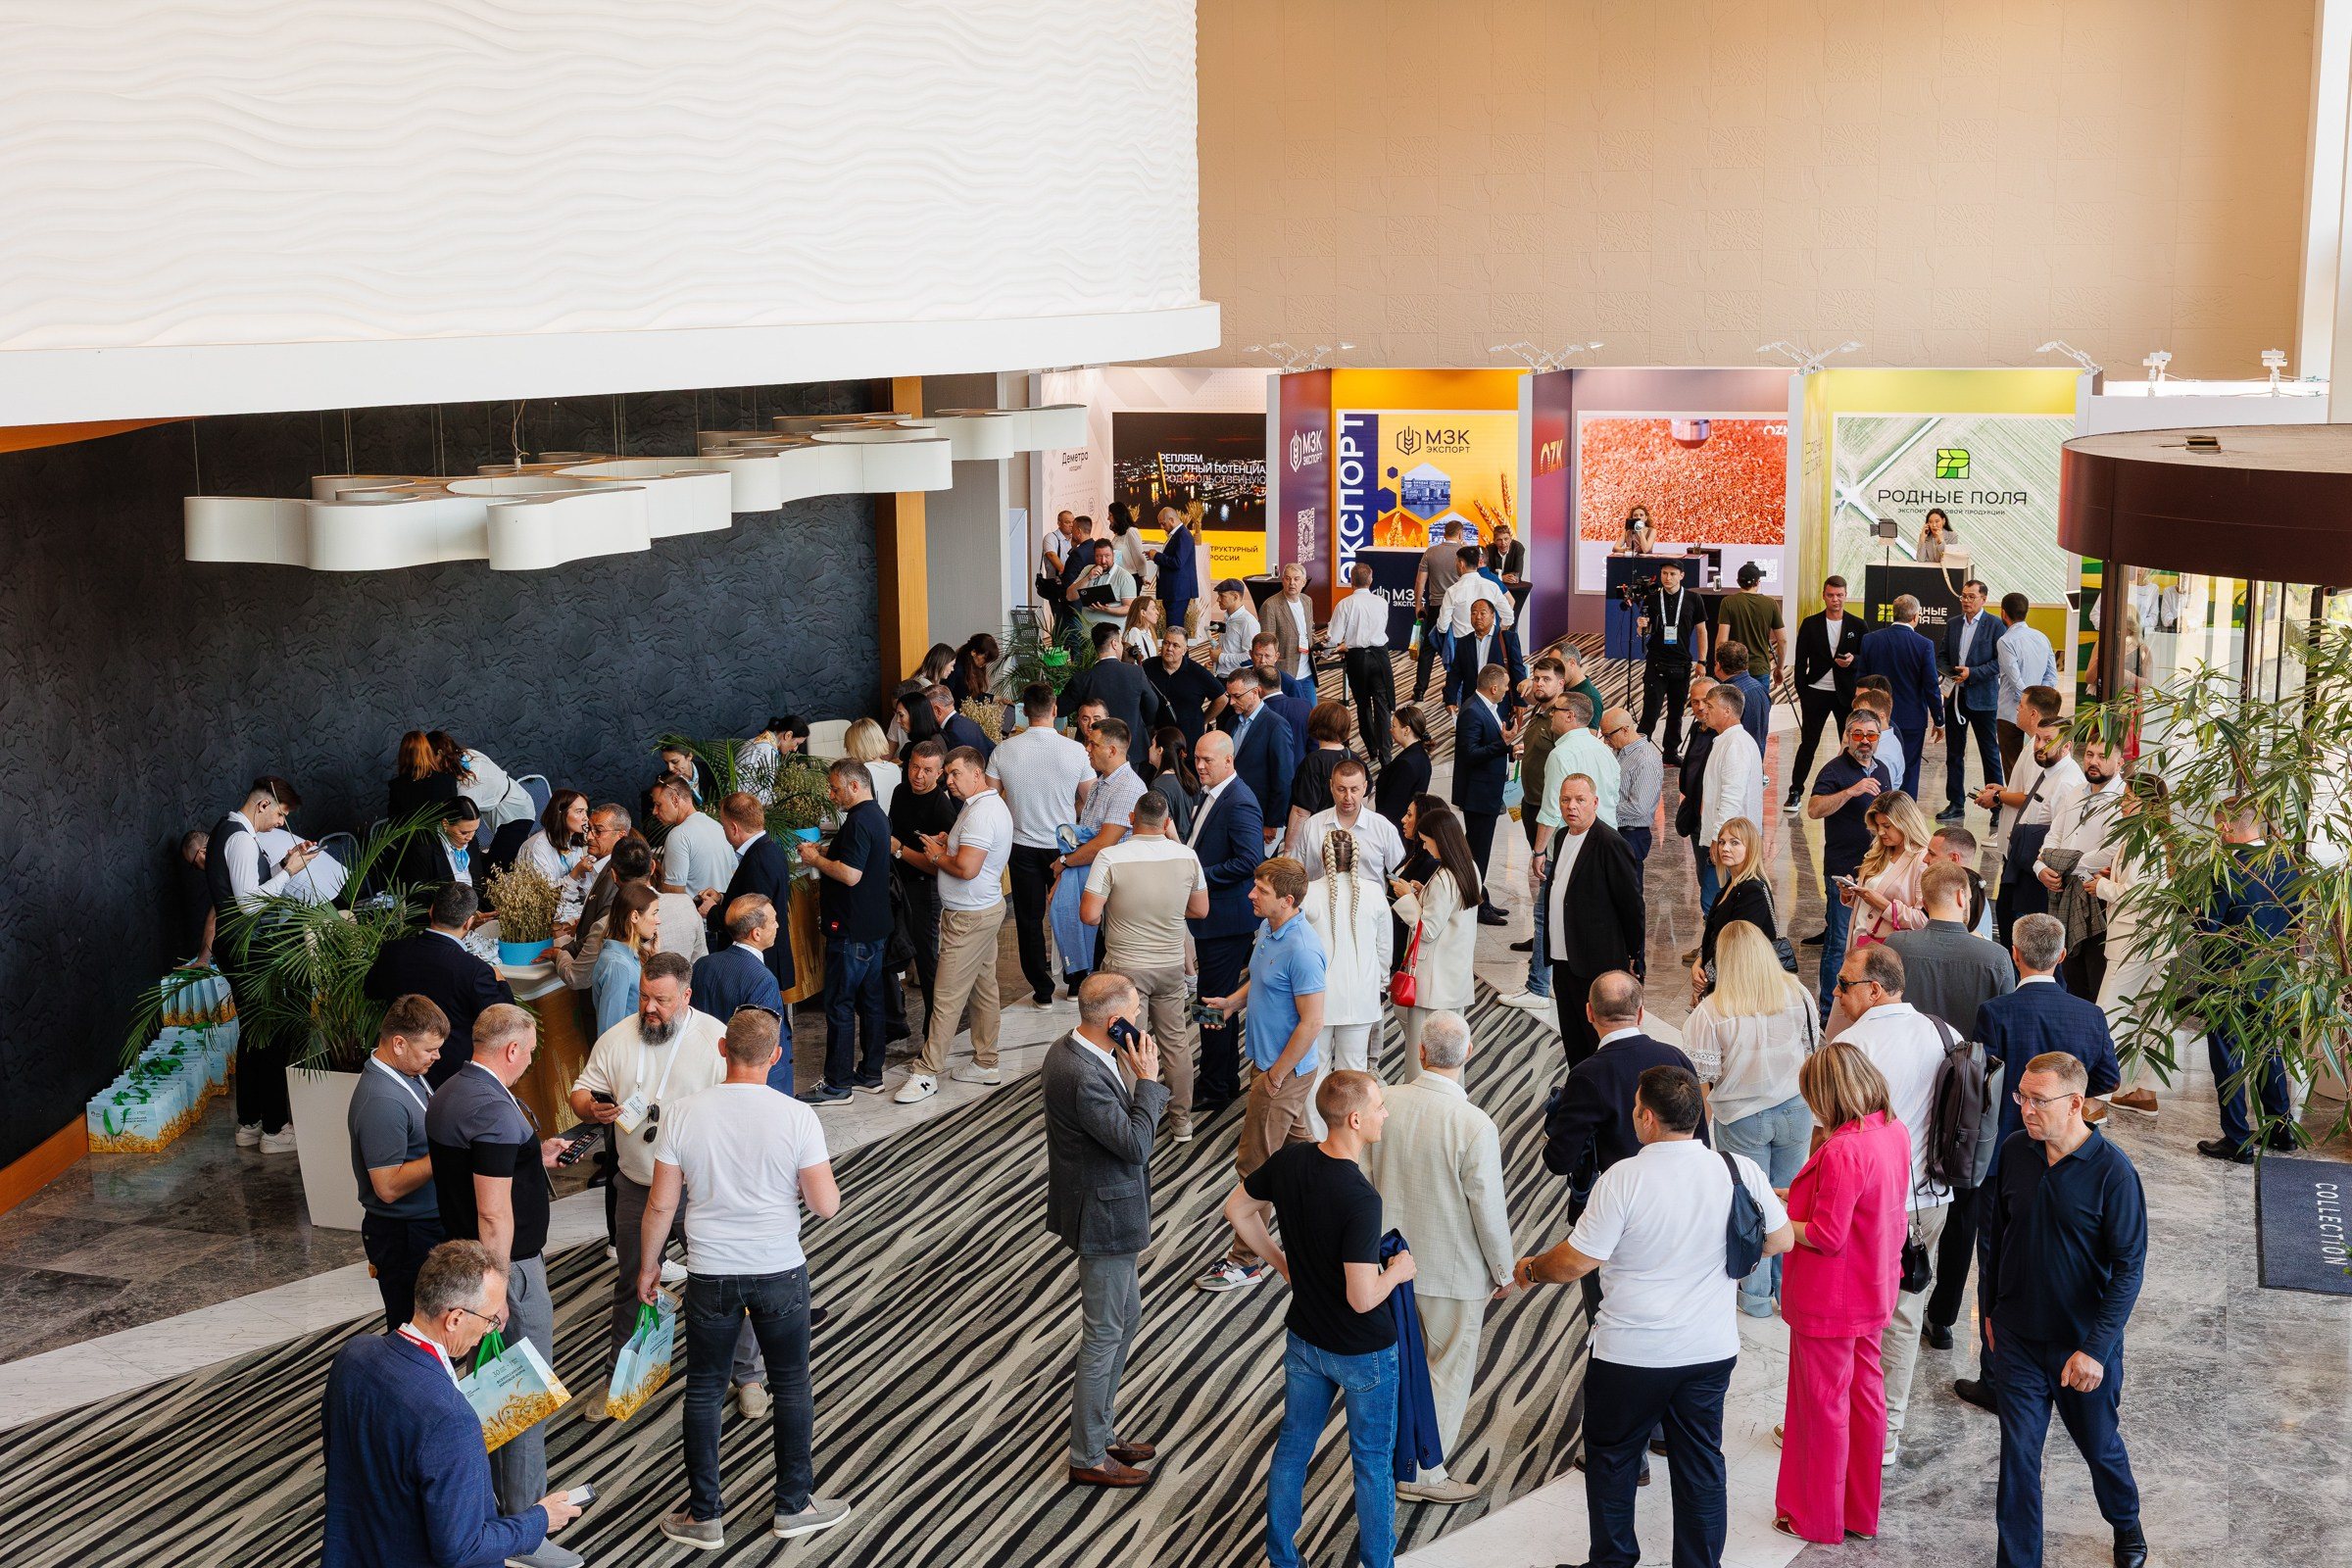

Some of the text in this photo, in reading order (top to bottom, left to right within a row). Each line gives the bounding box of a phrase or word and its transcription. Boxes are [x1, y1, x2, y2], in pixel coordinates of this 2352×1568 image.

[1302, 429, 1323, 455] МЗК
[1426, 429, 1470, 445] МЗК
[1878, 489, 2028, 506] РОДНЫЕ ПОЛЯ
[1210, 545, 1258, 554] ТРУКТУРНЫЙ
[1392, 588, 1427, 601] МЗ
[2315, 1182, 2348, 1266] COLLECTION
